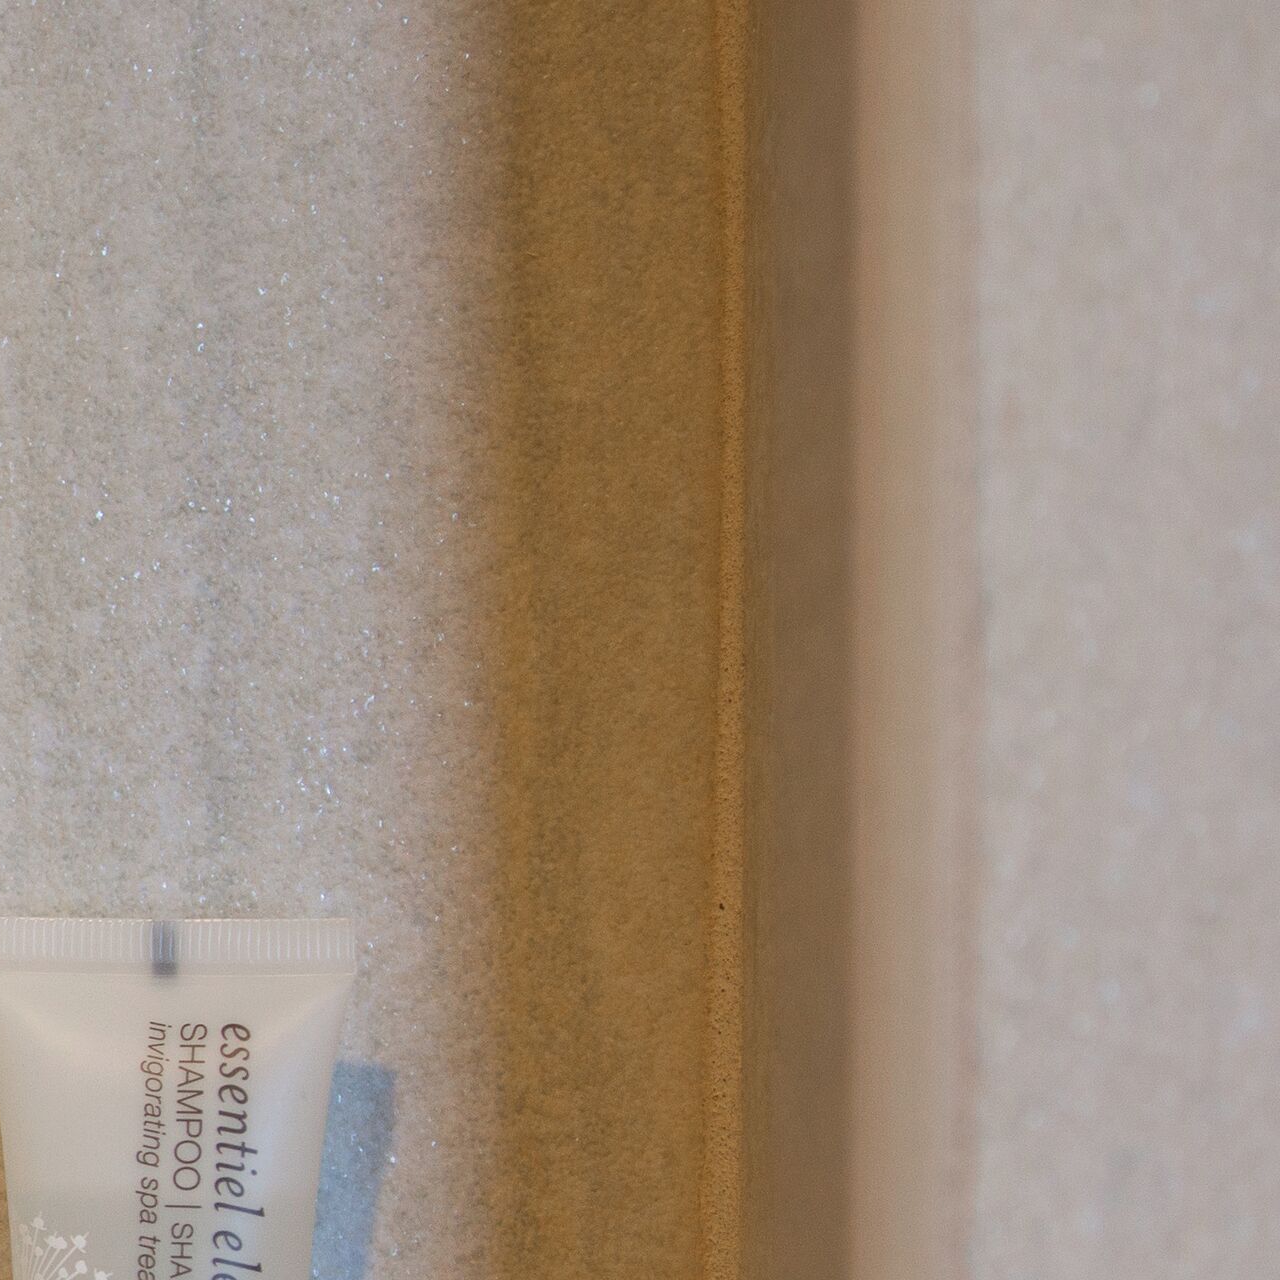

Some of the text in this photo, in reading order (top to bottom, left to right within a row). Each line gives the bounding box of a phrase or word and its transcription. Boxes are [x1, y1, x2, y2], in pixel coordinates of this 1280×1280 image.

[136, 1021, 172, 1167] invigorating
[173, 1022, 207, 1190] SHAMPOO
[213, 1023, 265, 1217] essentiel
[135, 1177, 160, 1224] spa
